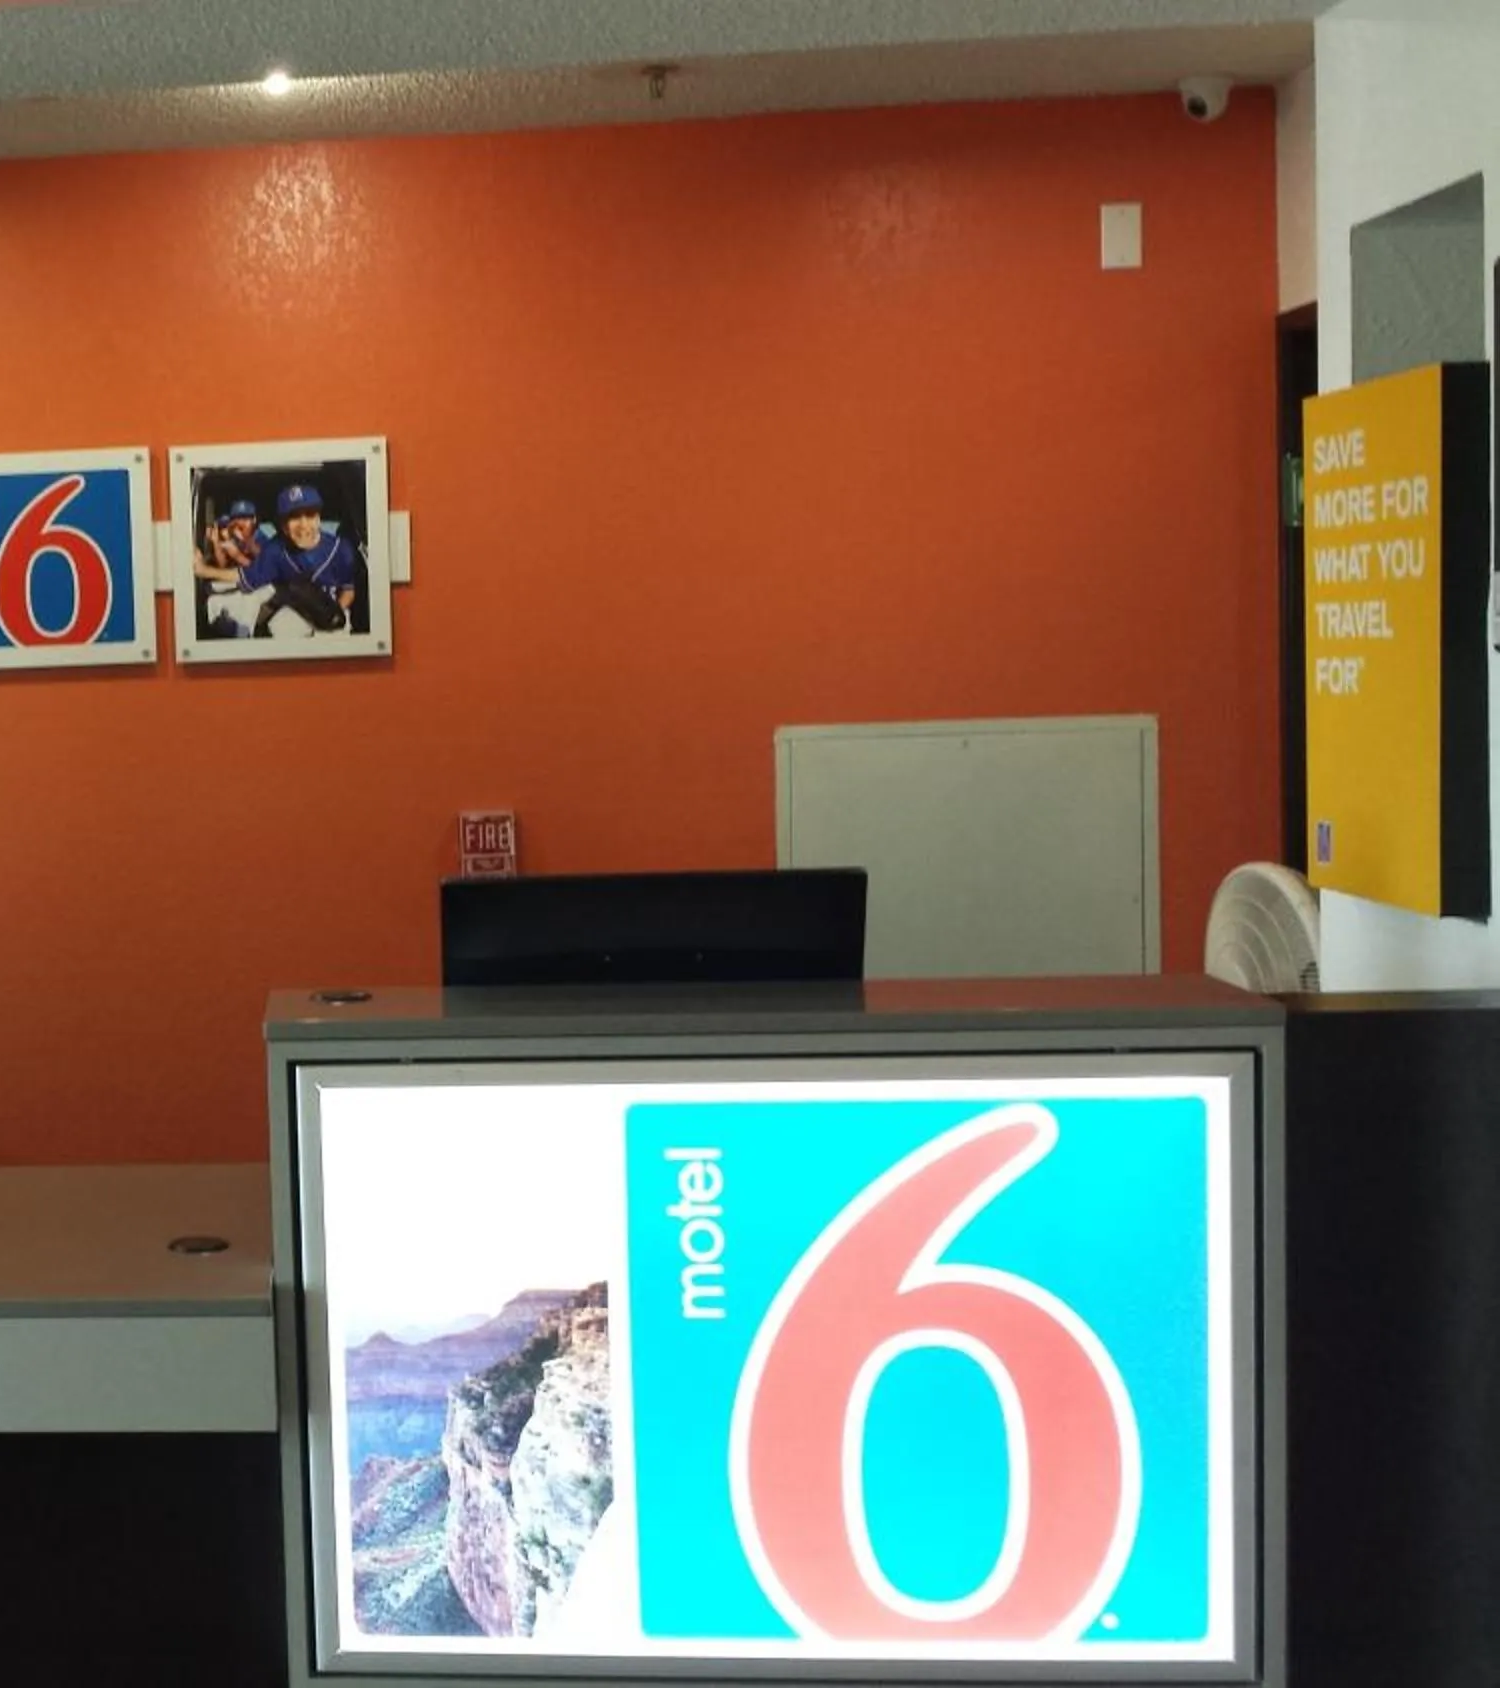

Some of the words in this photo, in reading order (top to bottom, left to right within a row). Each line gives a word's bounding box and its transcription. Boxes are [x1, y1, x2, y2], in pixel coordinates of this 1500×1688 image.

[1314, 431, 1365, 474] SAVE
[1314, 485, 1376, 528] MORE
[1382, 476, 1429, 520] FOR
[1314, 544, 1372, 586] WHAT
[1378, 536, 1425, 580] YOU
[1315, 599, 1395, 640] TRAVEL
[465, 822, 511, 850] FIRE
[664, 1147, 727, 1320] motel
[729, 1102, 1142, 1641] 6
